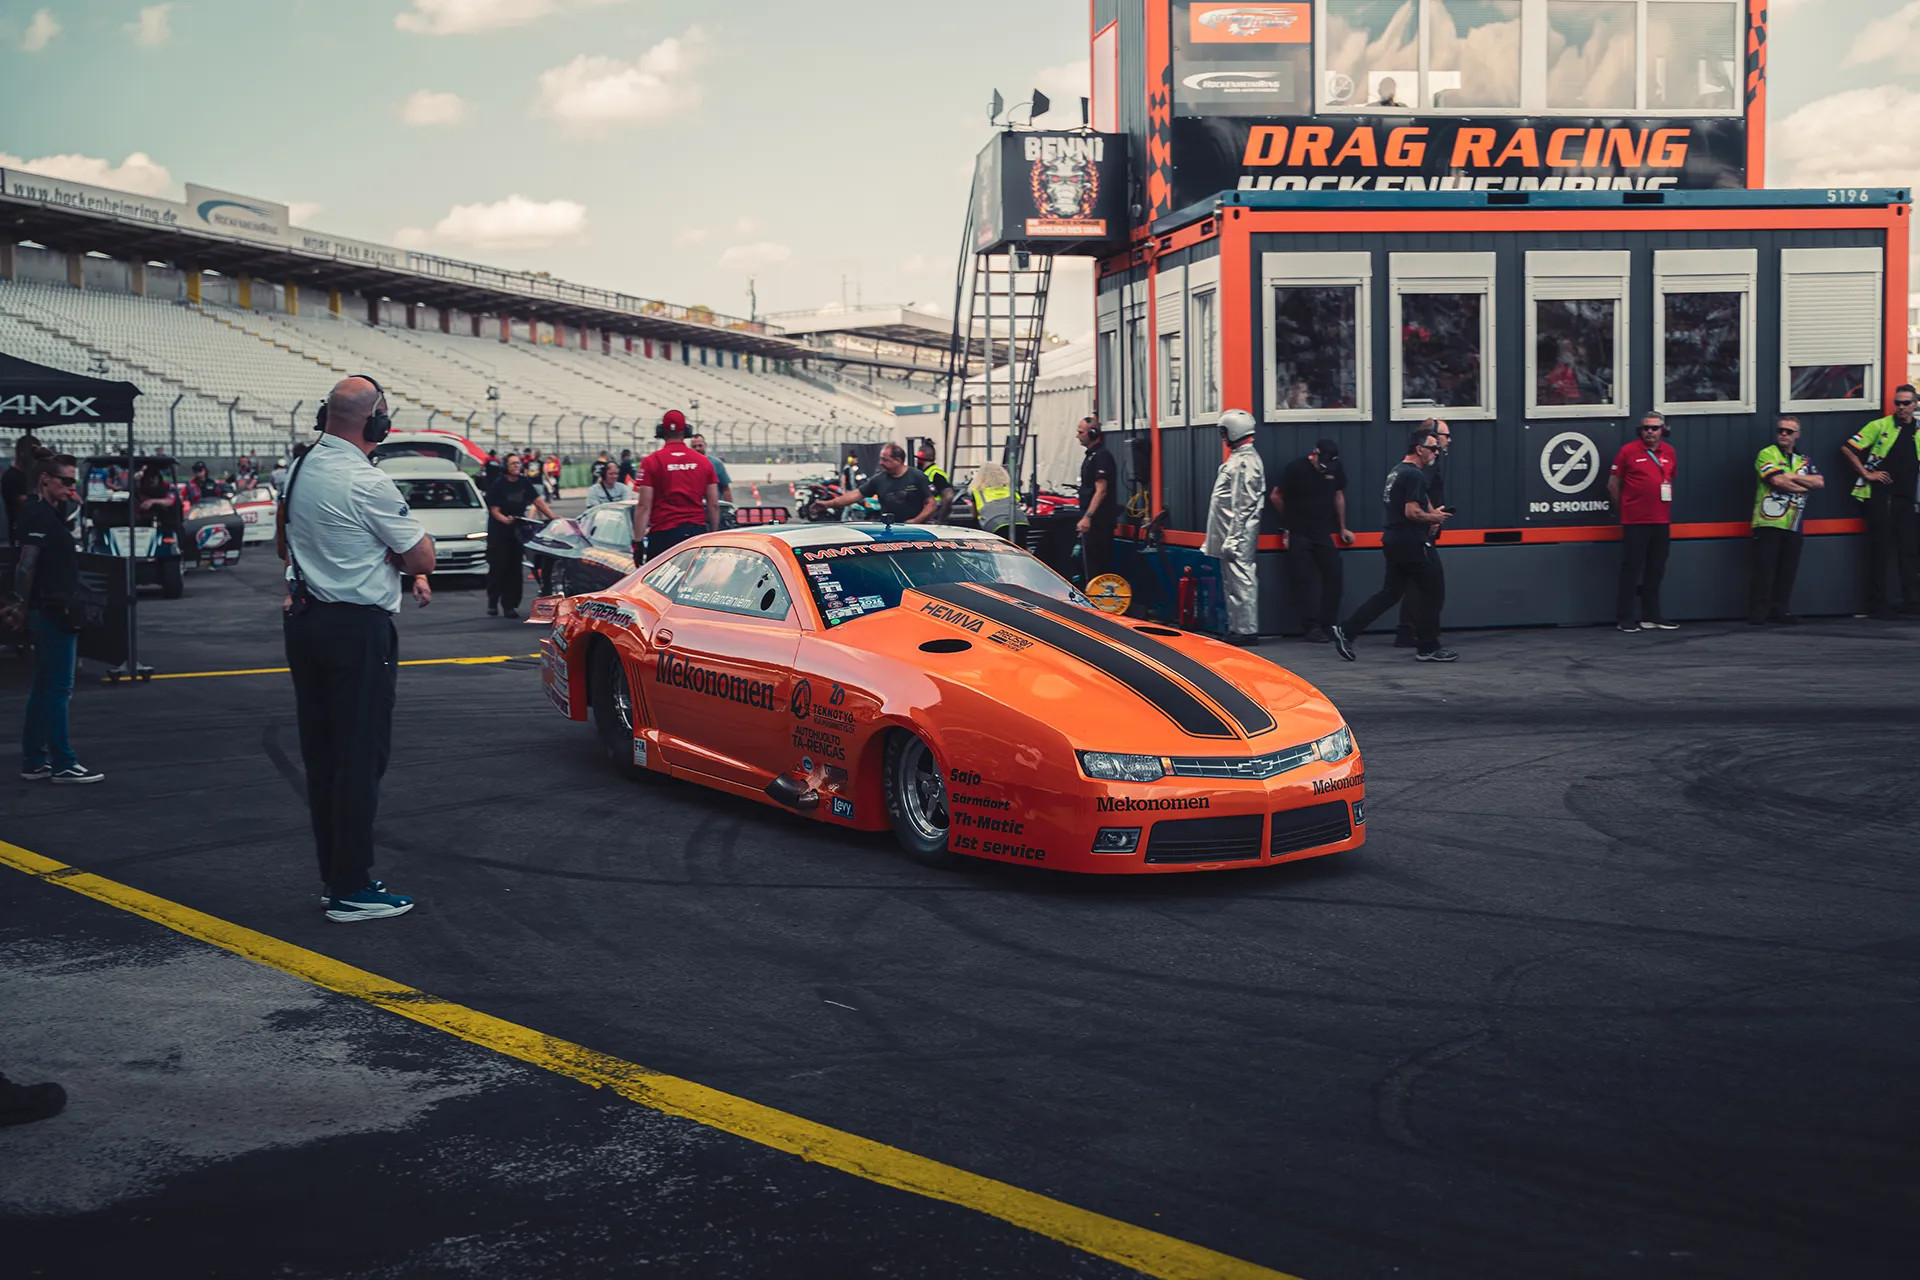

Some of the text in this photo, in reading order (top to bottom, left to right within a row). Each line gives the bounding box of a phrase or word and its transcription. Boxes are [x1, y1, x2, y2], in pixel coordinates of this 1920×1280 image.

[1024, 136, 1104, 162] BENNI
[1242, 125, 1691, 168] DRAG RACING
[13, 183, 178, 224] www.hockenheimring.de
[1827, 189, 1869, 203] 5196
[303, 235, 397, 267] MORE THAN RACING
[667, 463, 698, 471] STAFF
[1529, 501, 1610, 512] NO SMOKING
[649, 561, 686, 594] PM1
[690, 588, 710, 603] Jere
[920, 601, 985, 633] HEMIVA
[656, 651, 775, 711] Mekonomen
[792, 733, 845, 761] TA-RENGAS
[795, 725, 841, 746] AUTOHUOLTO
[950, 768, 981, 786] Sajo
[1096, 796, 1210, 812] Mekonomen
[954, 811, 1024, 835] Th-Matic
[982, 841, 1046, 861] service
